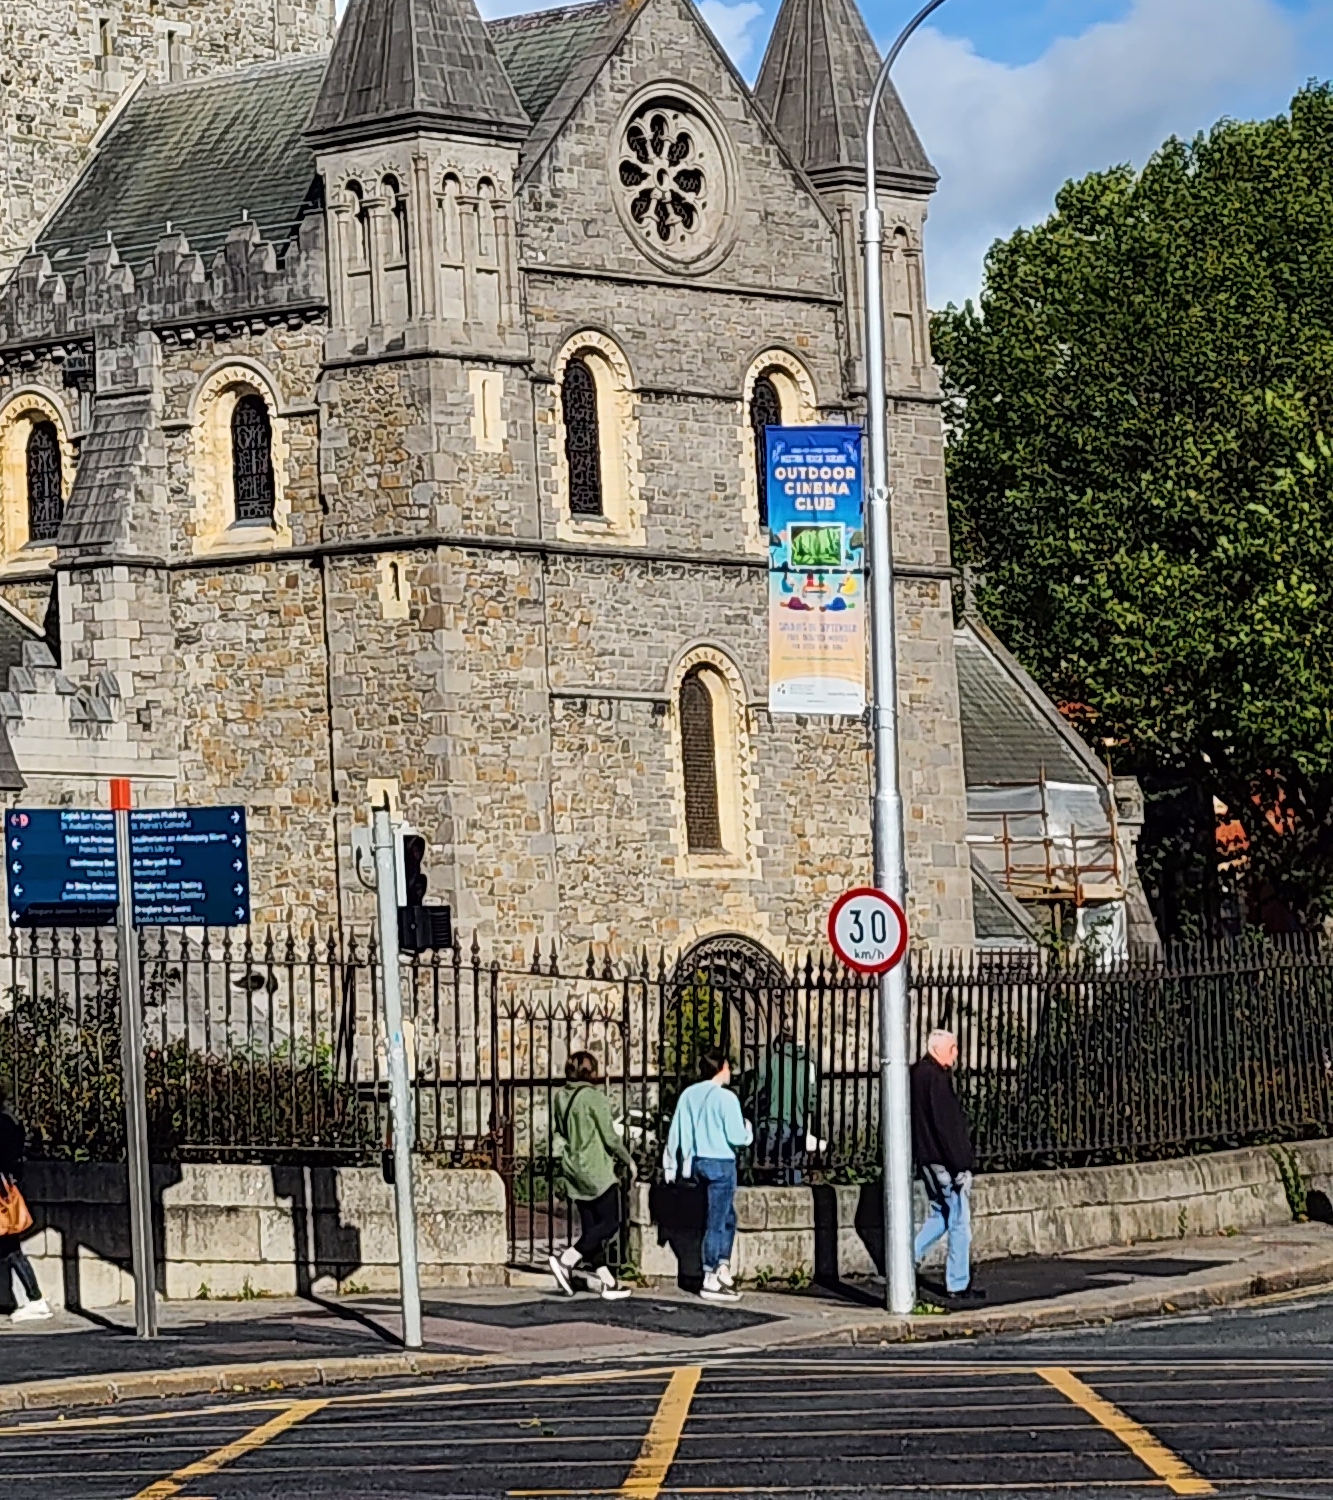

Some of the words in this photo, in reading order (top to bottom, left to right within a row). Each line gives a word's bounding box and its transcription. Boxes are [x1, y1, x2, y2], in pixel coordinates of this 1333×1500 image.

[775, 466, 856, 480] OUTDOOR
[784, 481, 851, 496] CINEMA
[795, 496, 835, 510] CLUB
[849, 910, 887, 943] 30
[854, 948, 885, 960] km/h
